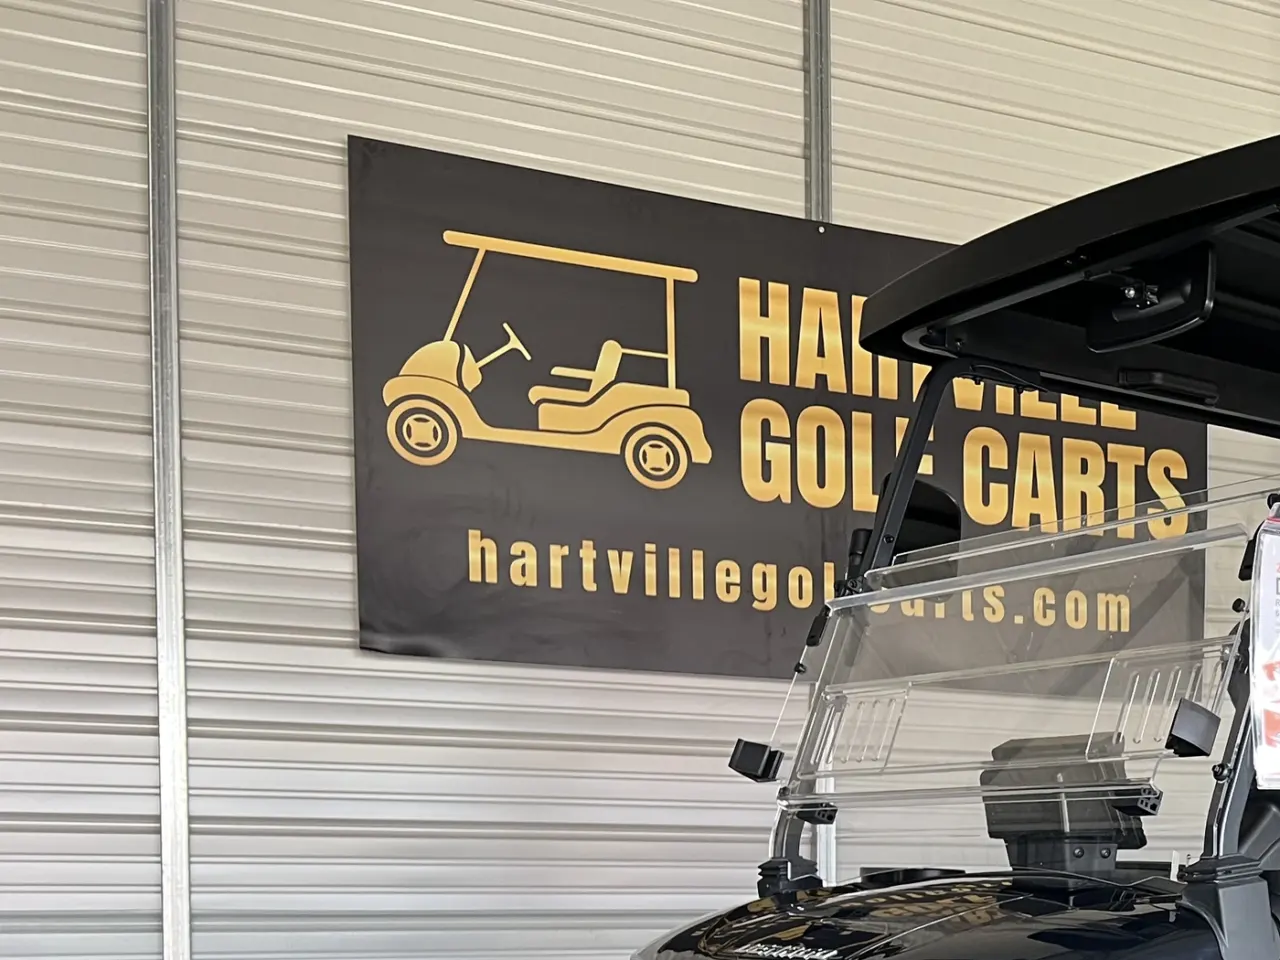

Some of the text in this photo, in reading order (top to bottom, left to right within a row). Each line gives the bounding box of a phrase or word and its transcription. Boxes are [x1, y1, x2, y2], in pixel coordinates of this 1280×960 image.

[739, 277, 1136, 430] HARLL
[963, 426, 1188, 540] CARTS
[468, 529, 1130, 632] hartvillegolts.com
